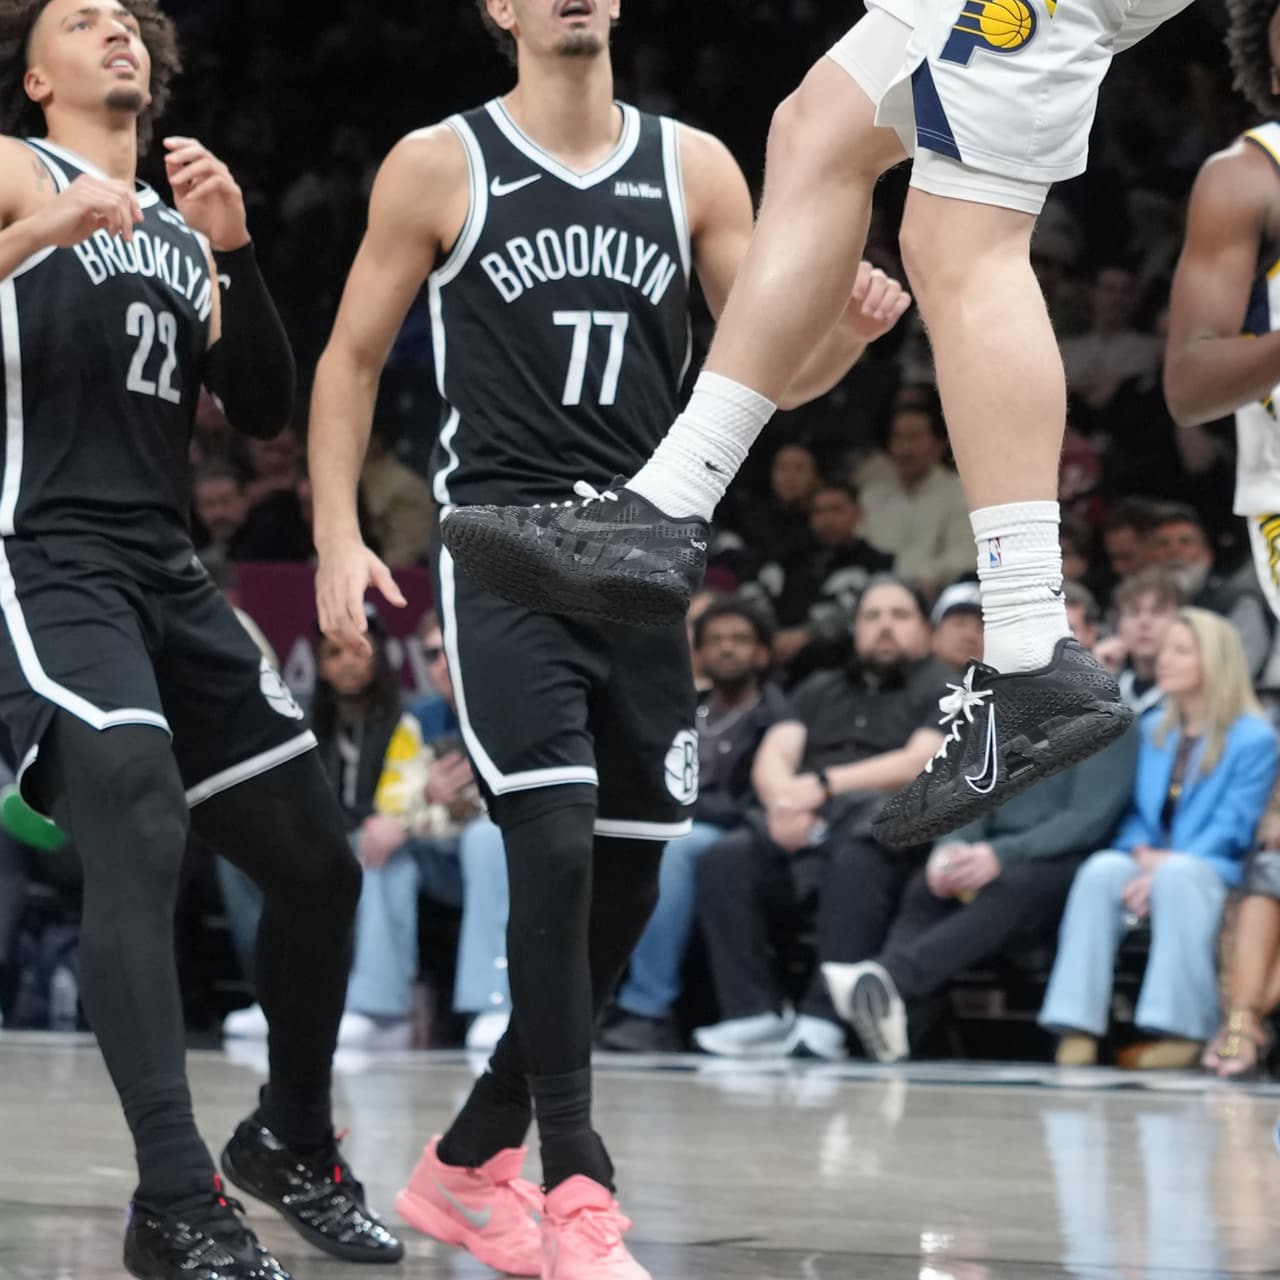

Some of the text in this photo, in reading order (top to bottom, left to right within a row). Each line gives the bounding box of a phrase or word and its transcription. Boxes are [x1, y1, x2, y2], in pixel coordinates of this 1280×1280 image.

[73, 228, 212, 322] BROOKLYN
[479, 223, 677, 306] BROOKLYN
[126, 301, 181, 405] 22
[552, 310, 630, 406] 77
